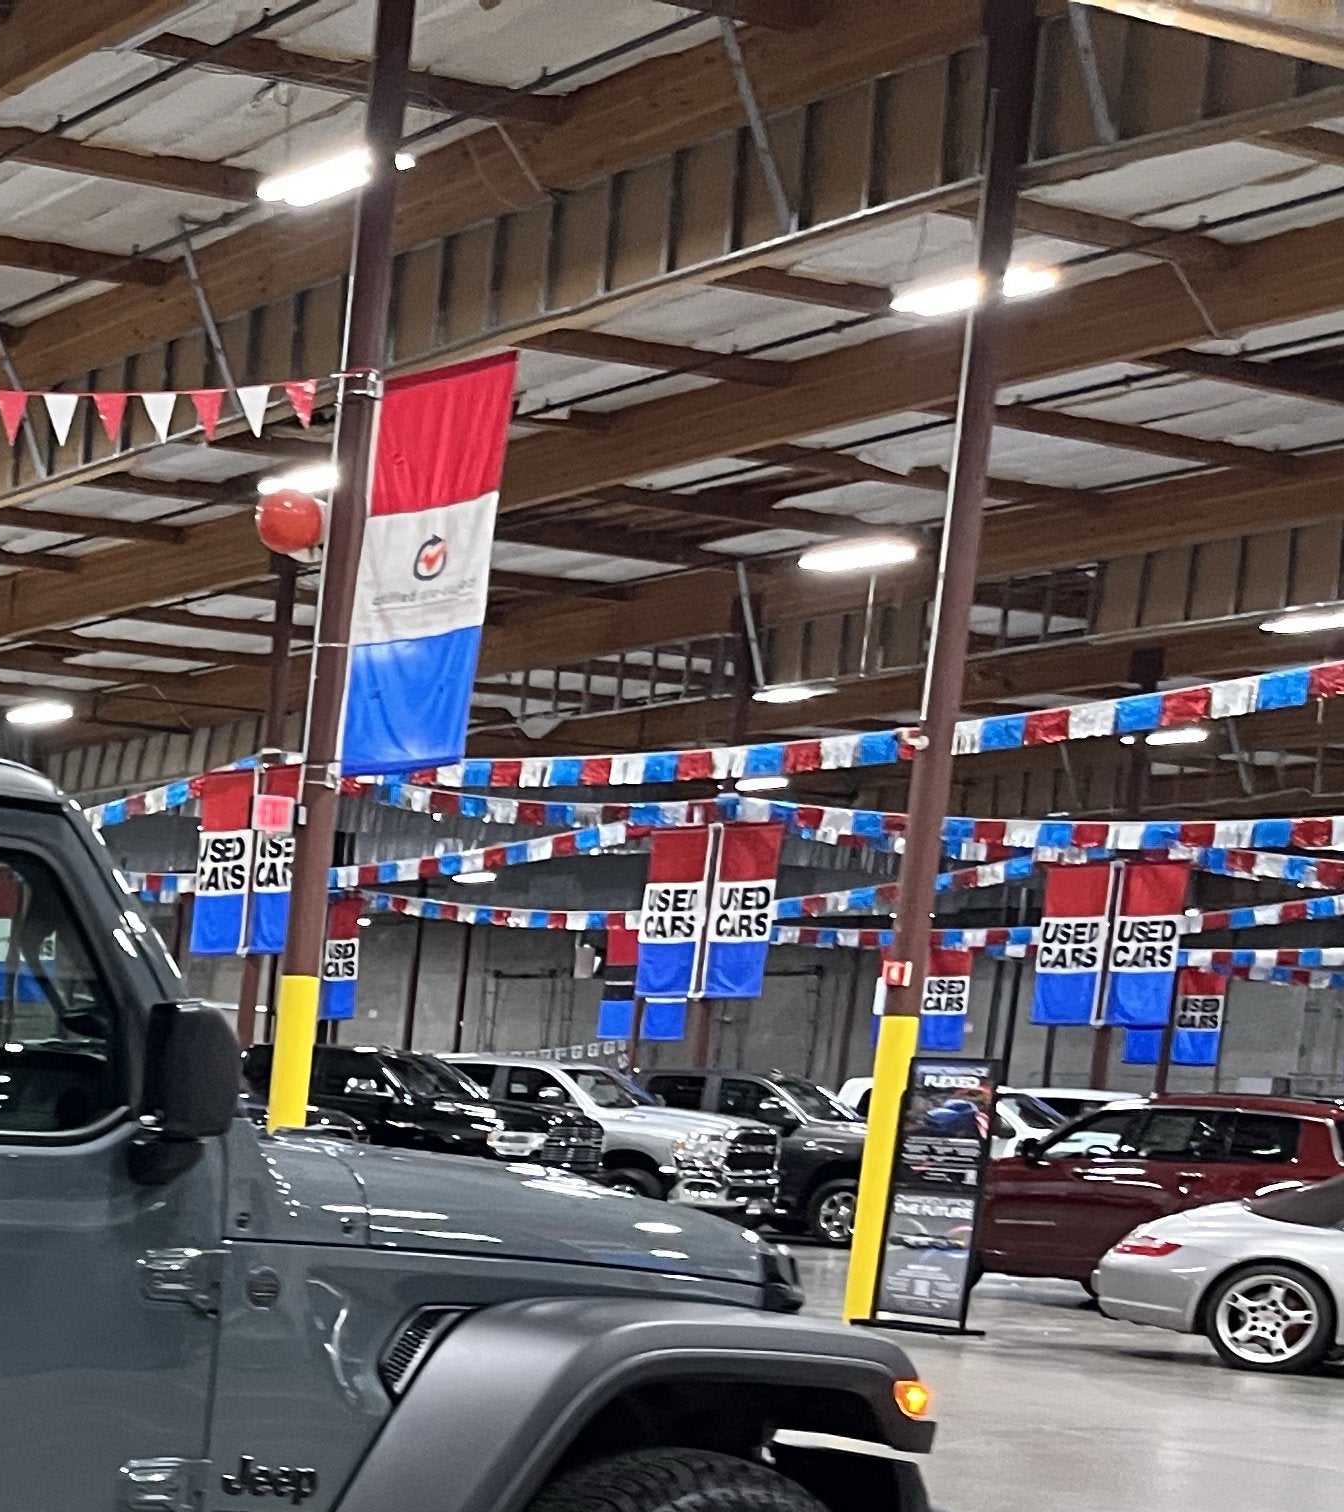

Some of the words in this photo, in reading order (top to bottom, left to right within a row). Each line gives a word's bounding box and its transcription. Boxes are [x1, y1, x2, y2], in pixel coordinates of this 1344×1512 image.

[648, 889, 699, 912] USED
[719, 886, 771, 911] USED
[644, 915, 696, 938] CARS
[715, 913, 769, 938] CARS
[1041, 922, 1100, 945] USED
[1117, 920, 1178, 943] USED
[1039, 945, 1098, 968] CARS
[1113, 945, 1174, 967] CARS
[222, 1455, 317, 1505] Jeep
